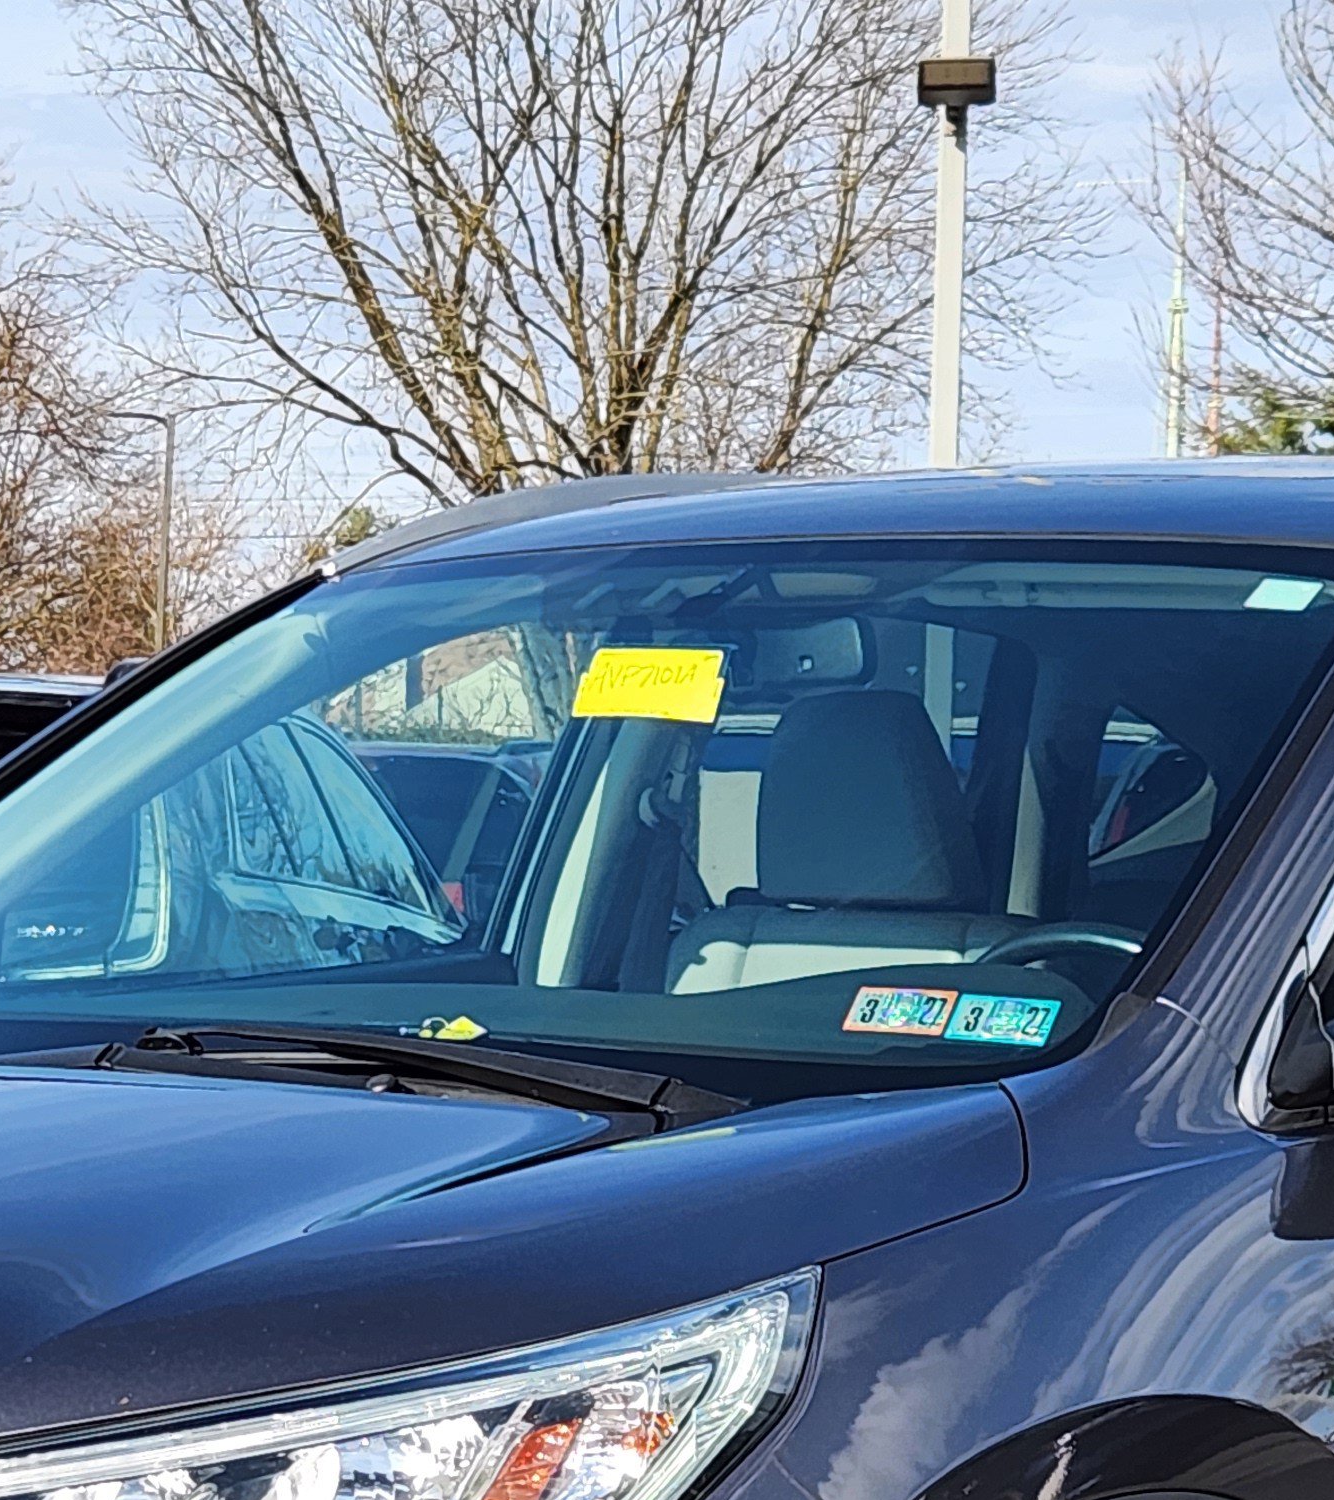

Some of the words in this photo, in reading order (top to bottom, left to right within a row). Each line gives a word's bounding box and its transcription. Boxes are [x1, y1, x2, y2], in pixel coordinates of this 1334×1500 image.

[860, 998, 880, 1024] 3
[918, 996, 950, 1027] 27
[964, 1006, 985, 1033] 3
[1021, 1006, 1052, 1036] 27
